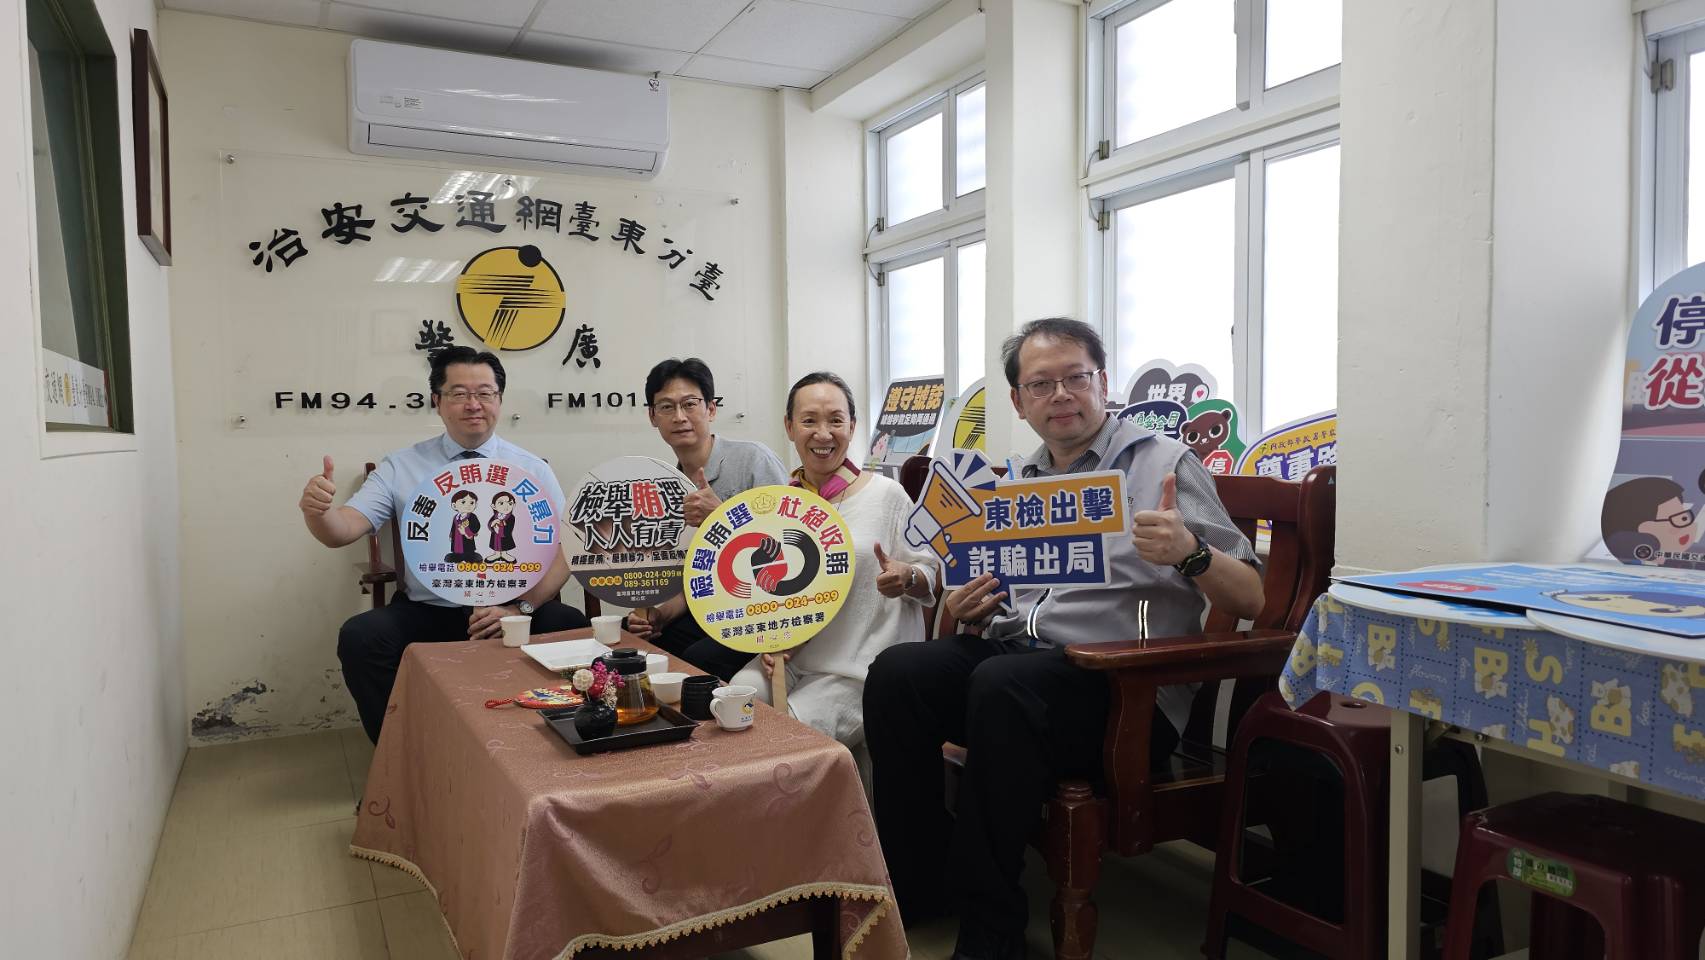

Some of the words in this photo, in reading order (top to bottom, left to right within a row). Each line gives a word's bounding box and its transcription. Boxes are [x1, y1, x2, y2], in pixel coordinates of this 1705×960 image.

[1656, 296, 1705, 346] 停
[562, 323, 601, 368] 廣
[1147, 383, 1187, 402] 世界
[1646, 357, 1703, 407] 從
[275, 391, 437, 409] FM94.3
[1207, 458, 1226, 474] 停
[433, 463, 509, 496] 反賄選
[512, 478, 555, 544] 反暴力
[571, 479, 685, 522] 檢舉賄選
[984, 488, 1114, 530] 東檢出擊
[585, 520, 683, 549] 人人有責
[690, 503, 753, 599] 檢舉賄選
[777, 495, 849, 575] 杜絕收賄
[419, 563, 454, 573] 檢舉電話
[456, 562, 542, 573] 0800-024-099
[968, 541, 1095, 578] 詐騙出局
[431, 579, 527, 588] 臺灣臺東地方檢察署
[706, 608, 744, 623] 檢舉電話
[746, 590, 839, 616] 0800-024-099
[721, 611, 826, 639] 臺灣臺東地方檢察署
